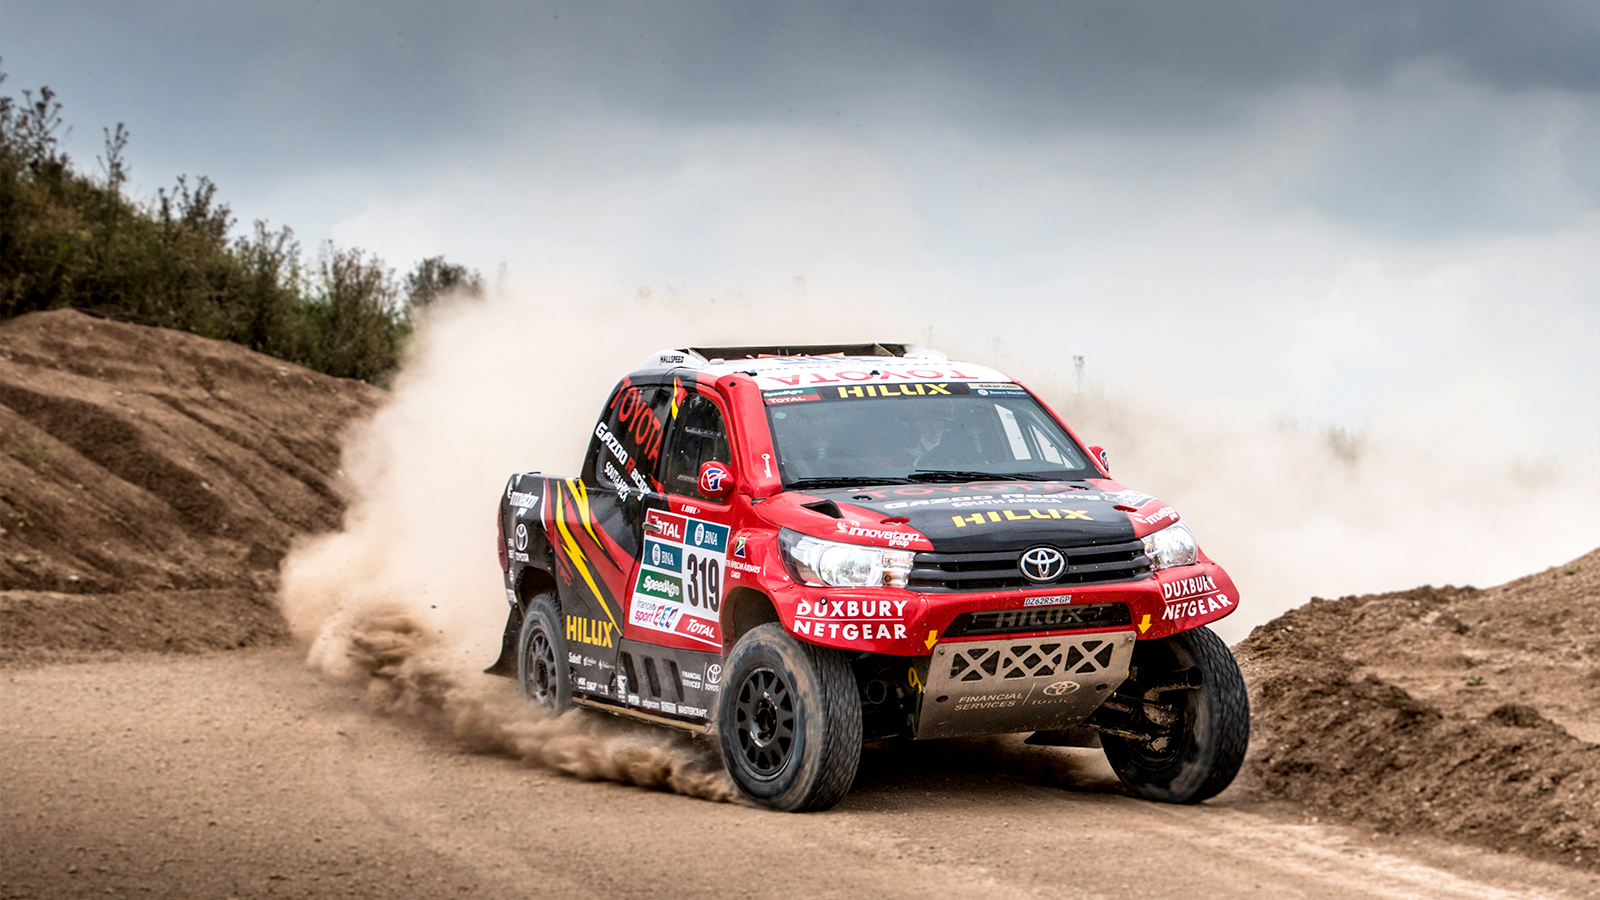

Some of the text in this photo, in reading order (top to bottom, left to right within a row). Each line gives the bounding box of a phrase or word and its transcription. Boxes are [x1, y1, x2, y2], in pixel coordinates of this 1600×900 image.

[837, 383, 952, 398] HILUX
[610, 376, 664, 470] TOYOTA
[595, 421, 651, 501] GAZOO Racing
[884, 495, 994, 509] GAZOO
[1001, 493, 1101, 501] Racing
[952, 499, 1006, 508] SOUTH
[952, 508, 1094, 528] HILUX
[704, 531, 718, 545] BNA
[848, 526, 921, 541] innovation
[888, 538, 910, 547] group
[661, 550, 674, 566] BNA
[687, 553, 720, 613] 319
[1162, 575, 1217, 598] DUXBURY
[796, 599, 908, 617] DUXBURY
[1162, 594, 1233, 619] NETGEAR
[634, 610, 654, 623] sport
[566, 614, 613, 648] HILUX
[686, 618, 715, 639] TOTAL
[793, 620, 908, 640] NETGEAR
[954, 701, 1016, 711] SERVICES
[958, 692, 1023, 703] FINANCIAL
